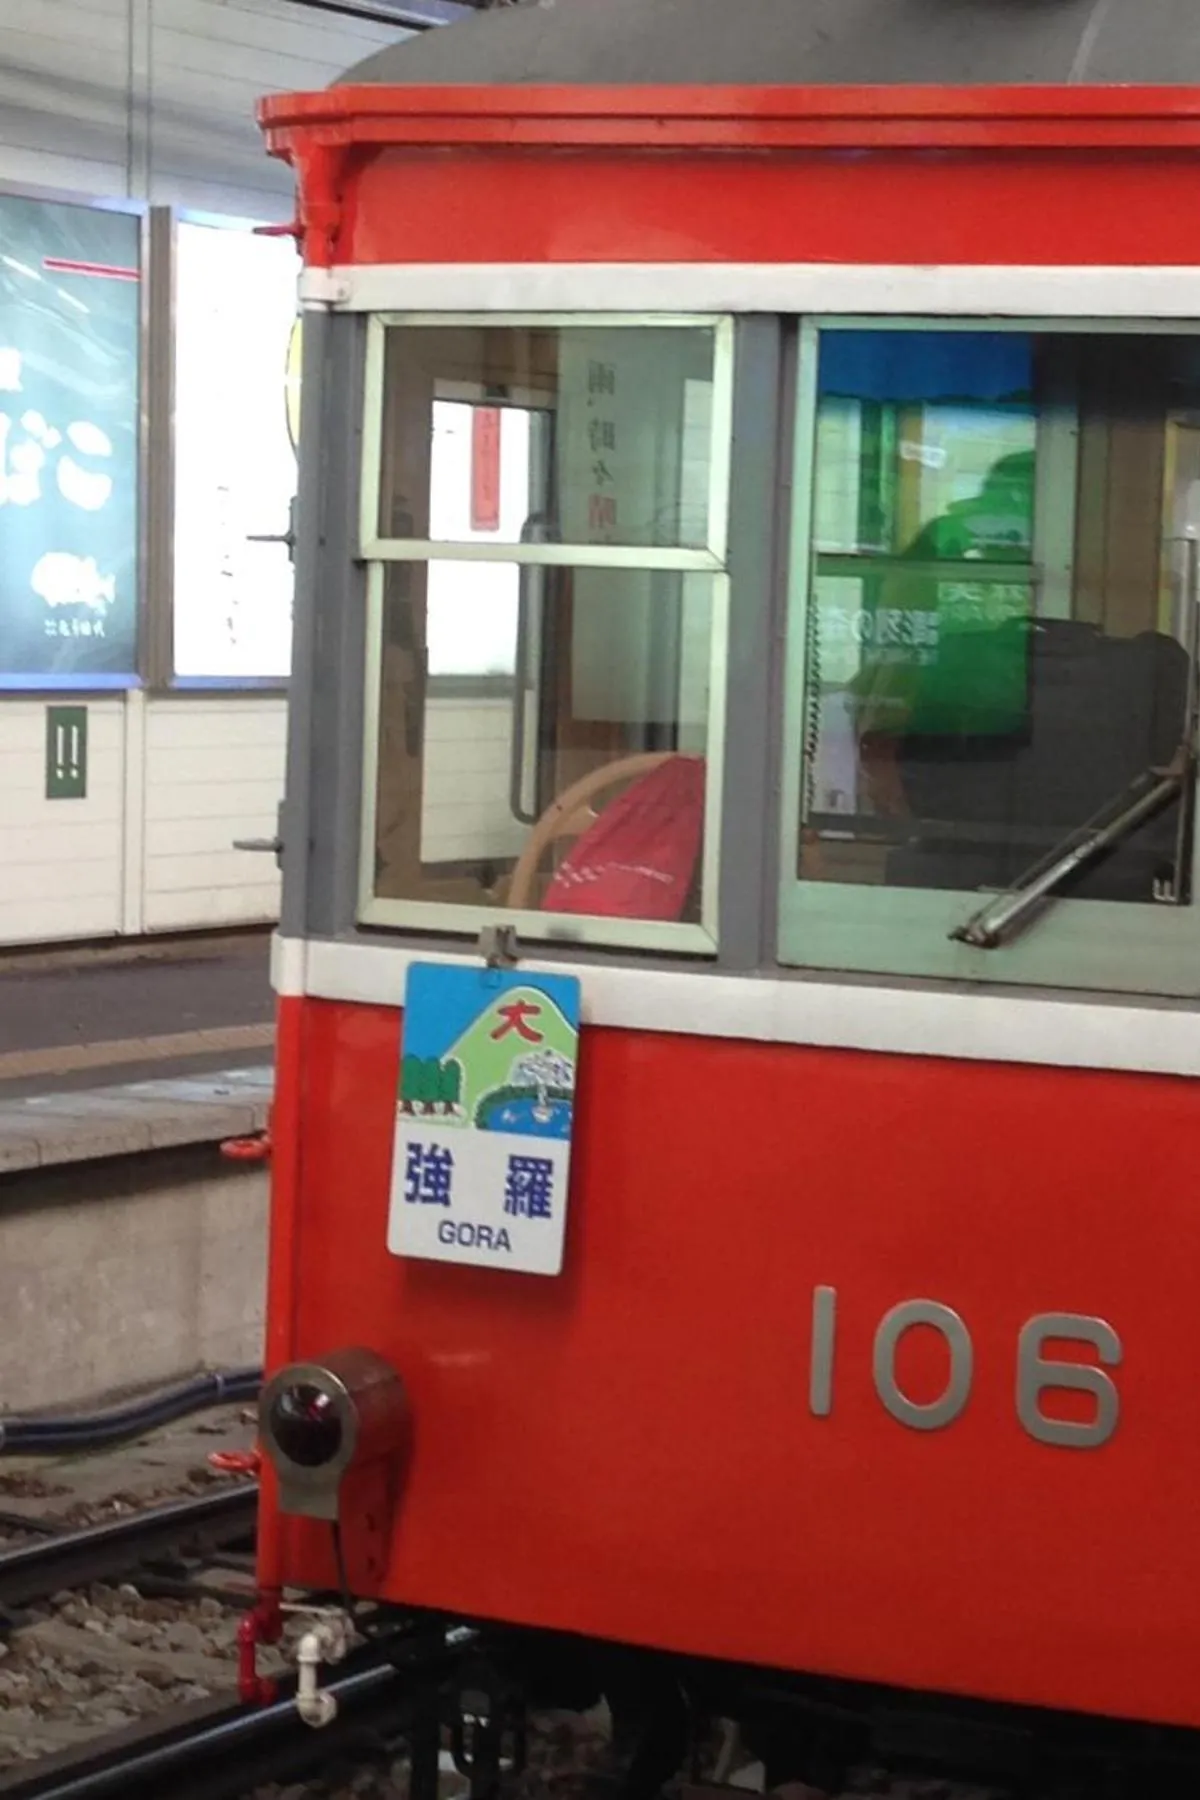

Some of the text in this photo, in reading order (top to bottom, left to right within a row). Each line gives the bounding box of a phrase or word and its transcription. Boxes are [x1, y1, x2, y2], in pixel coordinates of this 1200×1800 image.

[489, 999, 543, 1043] 大
[404, 1142, 554, 1220] 強羅
[437, 1219, 512, 1253] GORA
[809, 1284, 1123, 1449] 106
